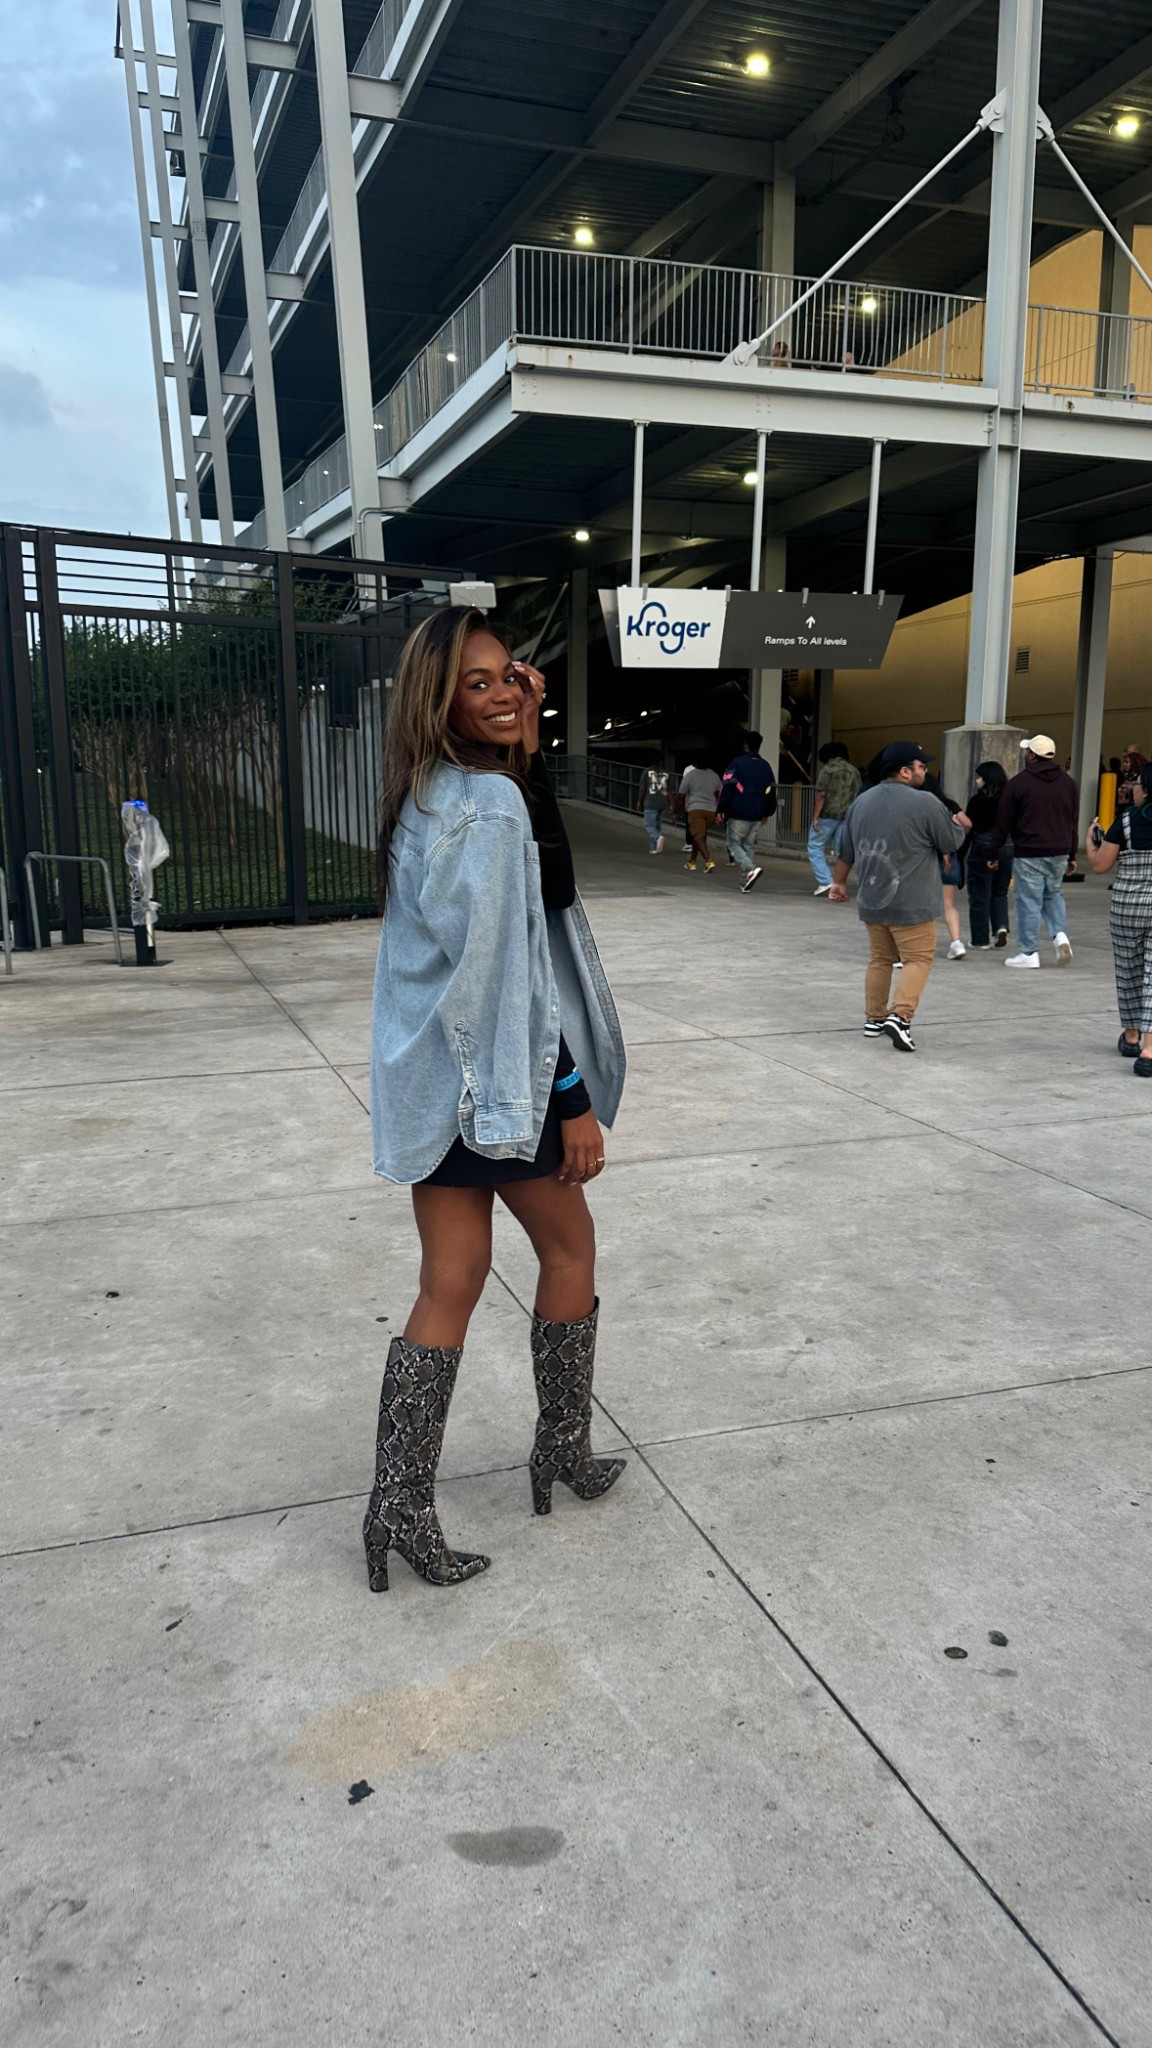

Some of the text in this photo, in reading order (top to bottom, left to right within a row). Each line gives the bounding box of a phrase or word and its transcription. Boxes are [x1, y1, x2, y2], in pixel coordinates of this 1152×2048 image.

[627, 601, 711, 655] Kroger
[765, 636, 847, 647] Ramps To All levels
